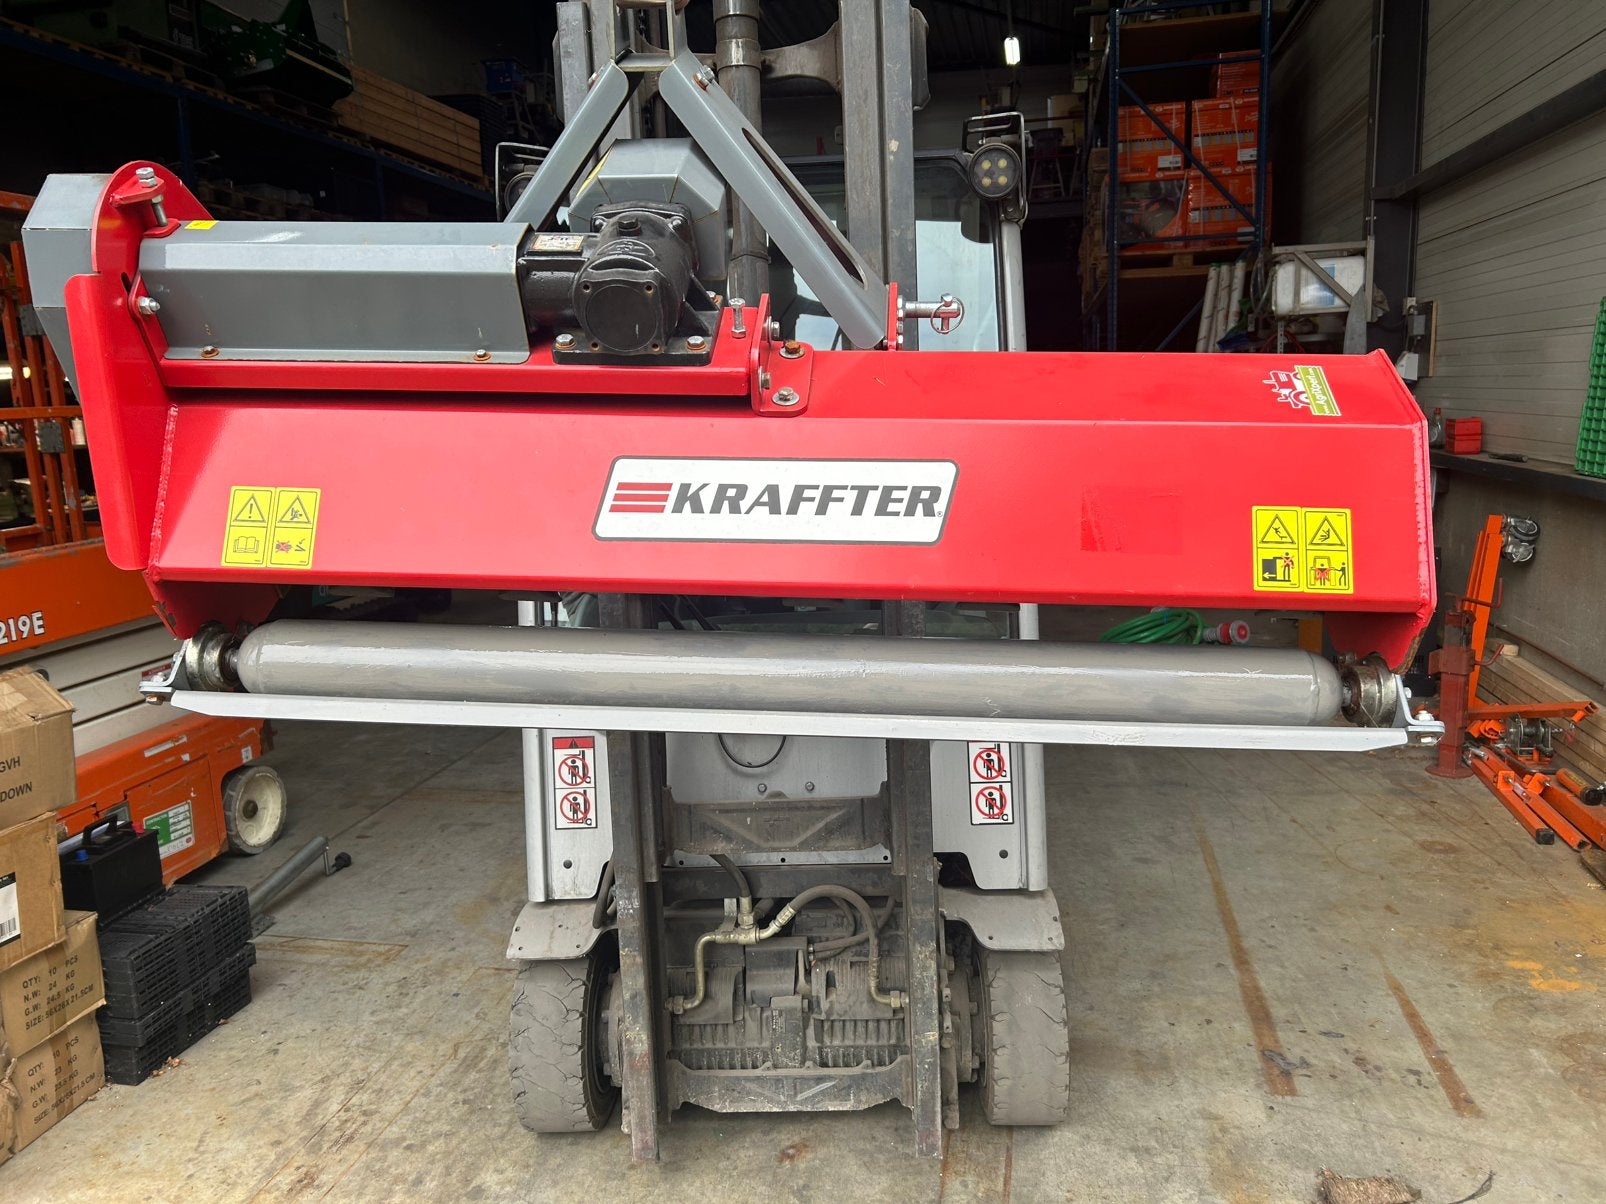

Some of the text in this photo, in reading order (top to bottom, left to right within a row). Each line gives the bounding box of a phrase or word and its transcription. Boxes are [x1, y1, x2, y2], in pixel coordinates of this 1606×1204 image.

[670, 482, 943, 518] KRAFFTER
[0, 611, 46, 645] 219E
[0, 781, 33, 803] DOWN
[22, 954, 79, 989] QTY: 10 PCS
[65, 969, 76, 981] KG
[65, 983, 75, 994] KG
[25, 1014, 44, 1031] SIZE:
[65, 1035, 79, 1050] PCS
[67, 1054, 78, 1066] KG
[68, 1069, 79, 1082] KG
